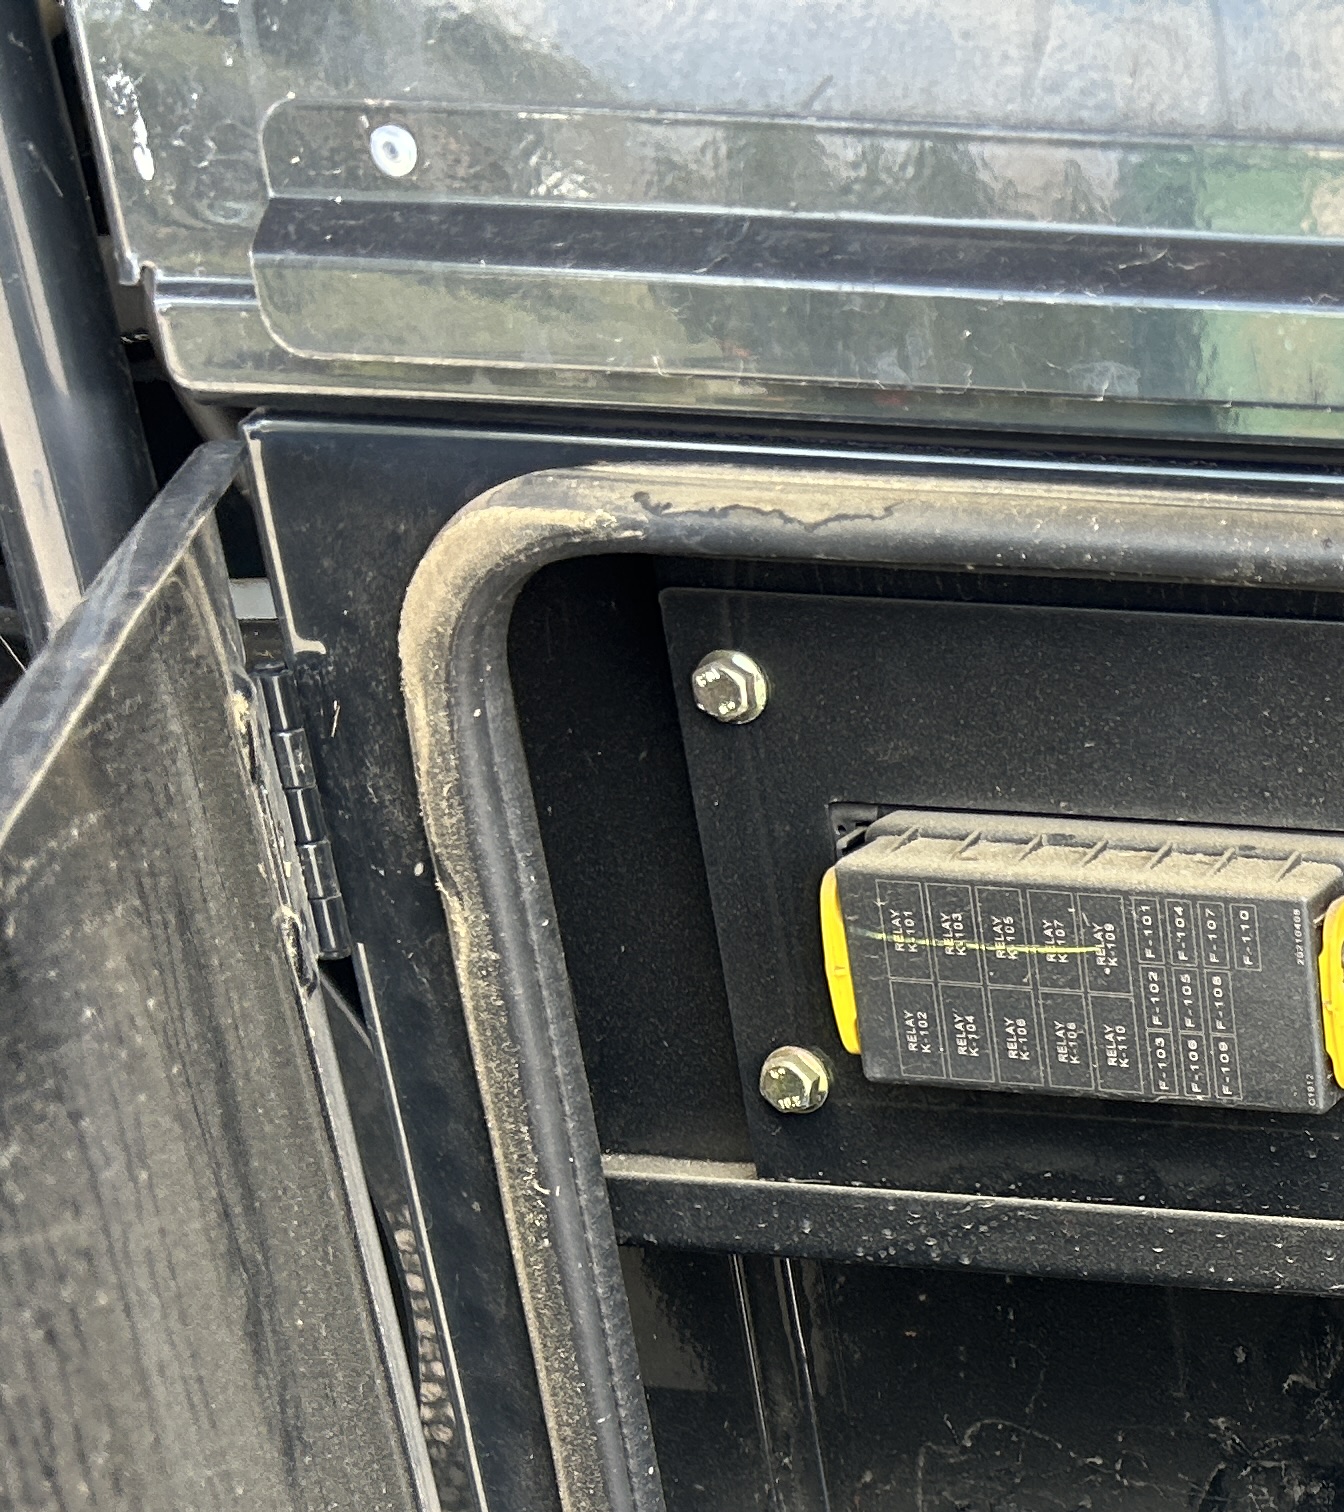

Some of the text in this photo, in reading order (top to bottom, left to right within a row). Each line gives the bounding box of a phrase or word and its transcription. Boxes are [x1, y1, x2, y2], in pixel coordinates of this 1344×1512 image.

[891, 909, 905, 952] RELAY
[903, 911, 918, 953] K-101
[941, 912, 955, 955] RELAY
[952, 913, 967, 956] K-103
[992, 916, 1006, 958] RELAY
[1004, 917, 1018, 960] K105
[1055, 920, 1068, 963] K107
[1093, 922, 1107, 965] RELAY
[1105, 923, 1118, 967] K-109
[1140, 905, 1156, 958] F-101
[1173, 906, 1189, 961] F-104
[1205, 908, 1220, 963] F-107
[1239, 910, 1253, 965] F-110
[1148, 971, 1163, 1025] F-102
[904, 1010, 918, 1052] RELAY
[917, 1011, 931, 1053] K-102
[954, 1014, 968, 1055] RELAY
[966, 1015, 979, 1057] K-104
[1004, 1017, 1018, 1059] RELAY
[1054, 1021, 1068, 1063] RELAY
[1104, 1024, 1118, 1067] RELAY
[1116, 1026, 1130, 1068] K-110
[1155, 1037, 1170, 1090] F-103
